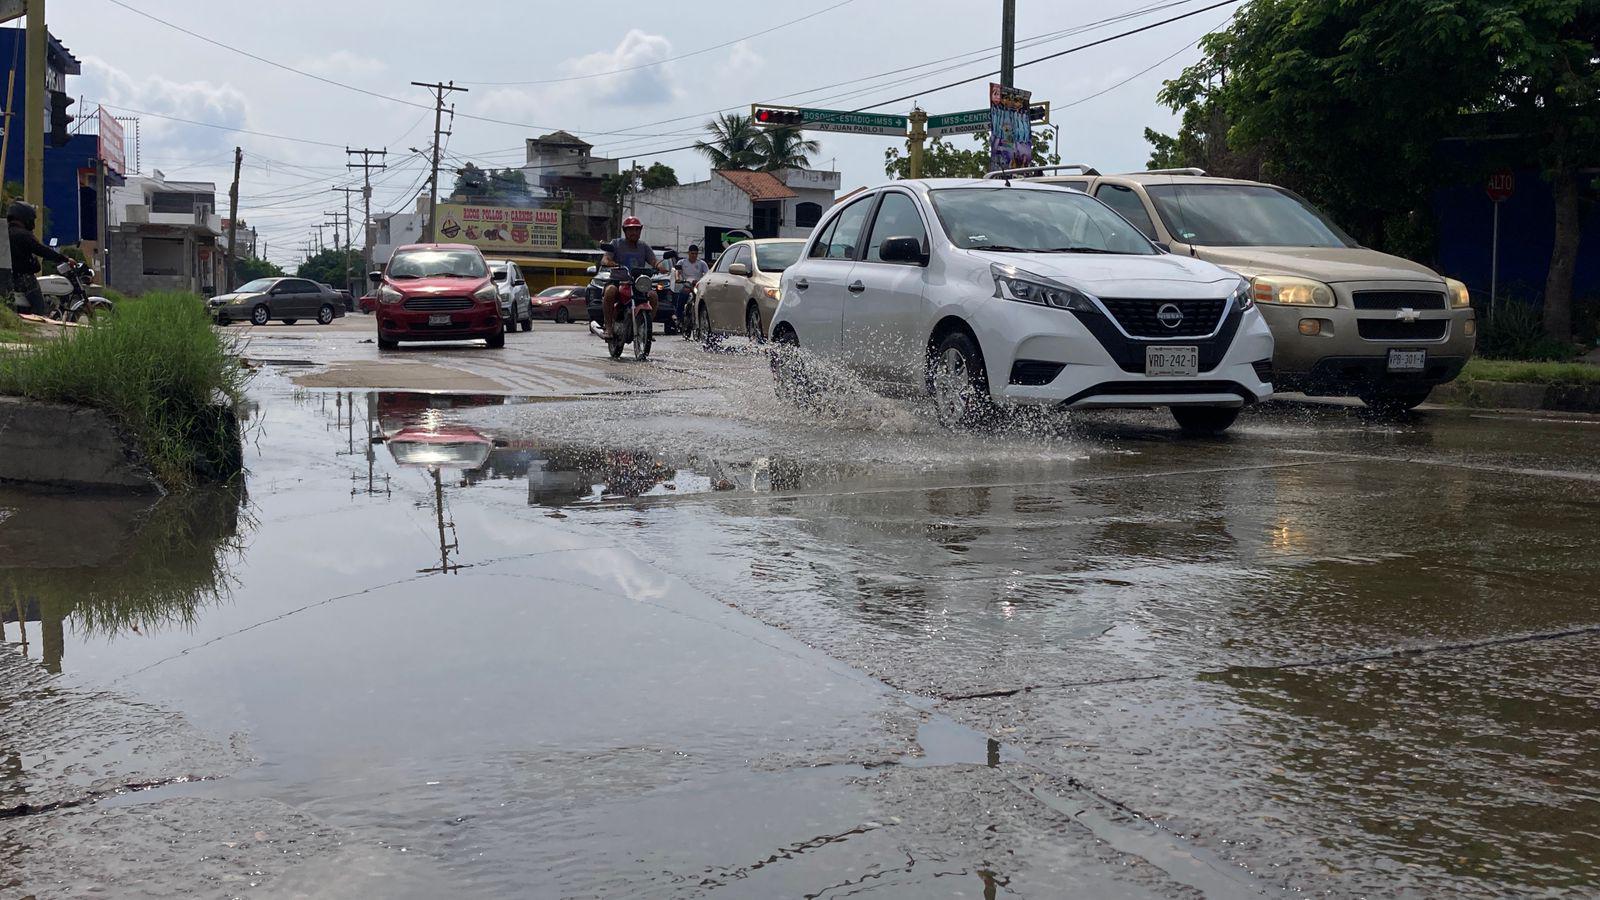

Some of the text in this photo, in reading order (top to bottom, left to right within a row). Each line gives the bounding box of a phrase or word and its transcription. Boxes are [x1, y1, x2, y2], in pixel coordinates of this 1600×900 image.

[853, 125, 878, 133] PABLO
[1488, 175, 1512, 190] ALTO
[482, 208, 503, 221] POLLOS
[535, 211, 558, 223] ASADAS
[1148, 354, 1197, 368] VRD-242-D
